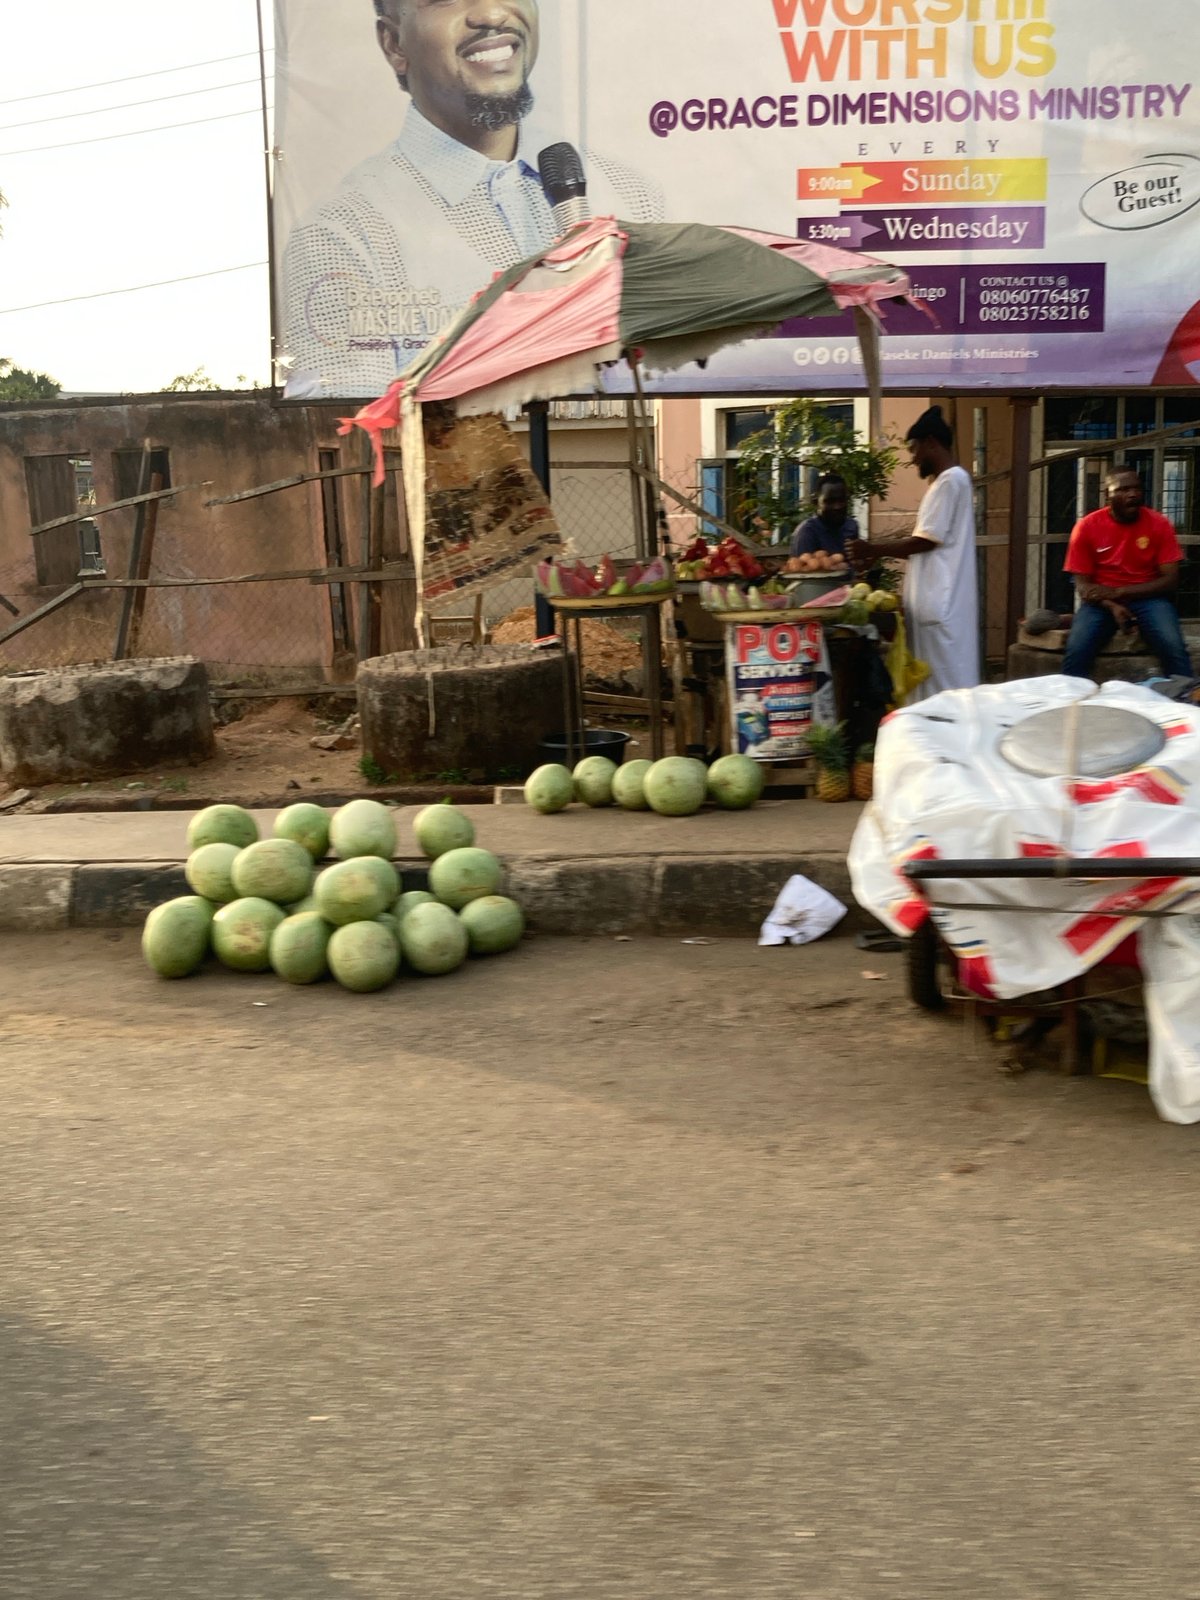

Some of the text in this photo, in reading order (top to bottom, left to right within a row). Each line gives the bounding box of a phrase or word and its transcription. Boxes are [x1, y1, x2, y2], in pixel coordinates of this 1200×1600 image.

[779, 22, 1057, 83] WITH US
[649, 83, 1193, 138] @GRACE DIMENSIONS MINISTRY
[857, 139, 1000, 156] EVERY
[808, 166, 1003, 196] 9:00am Sunday
[1113, 175, 1179, 197] Be our
[1117, 187, 1183, 213] Guest!
[808, 215, 1030, 244] 5:30pm Wednesday
[908, 284, 947, 301] ingo
[979, 276, 1037, 287] CONTACT
[1038, 276, 1055, 286] US
[979, 288, 1091, 305] 08060776487
[349, 307, 423, 337] MASEKE
[979, 305, 1091, 322] 08023758216
[879, 347, 1040, 361] aseke Daniels Ministries
